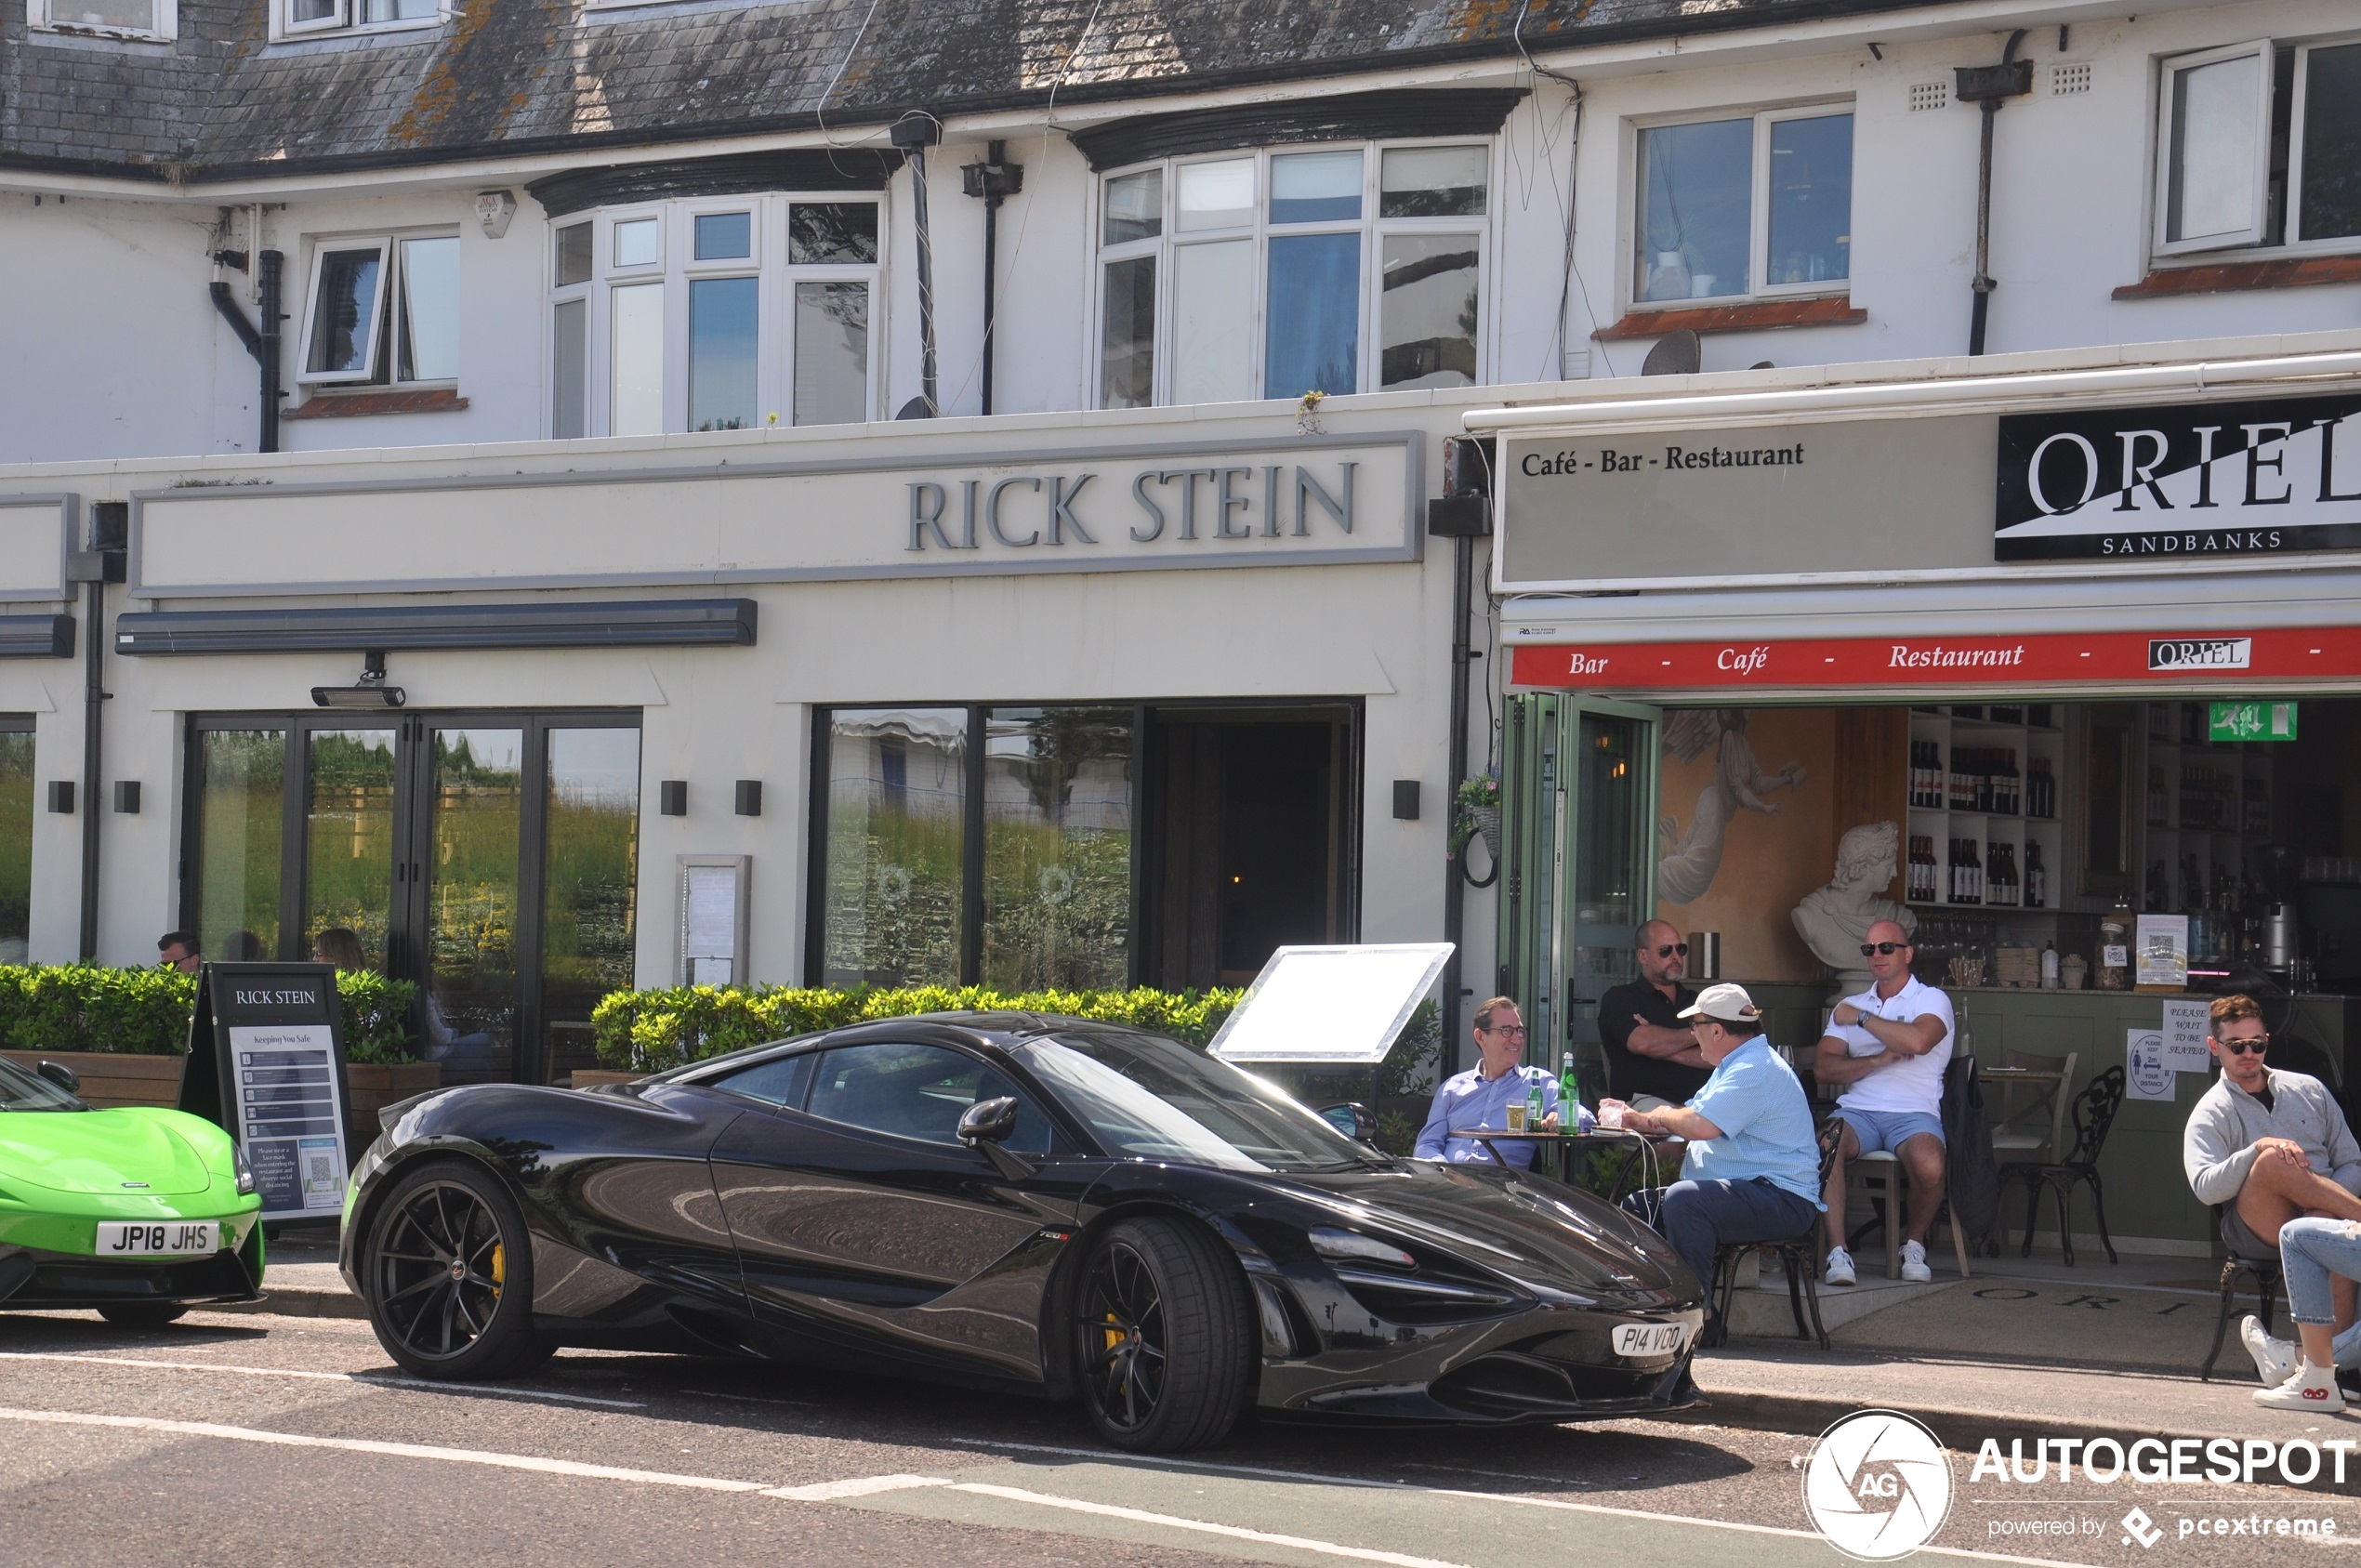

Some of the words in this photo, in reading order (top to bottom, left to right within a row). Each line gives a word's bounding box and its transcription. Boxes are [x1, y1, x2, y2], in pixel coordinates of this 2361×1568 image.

[1522, 451, 1577, 477] Café
[1601, 450, 1642, 473] Bar
[1665, 443, 1804, 470] Restaurant
[2028, 418, 2361, 517] ORIEL
[904, 474, 1100, 551] RICK
[1130, 462, 1360, 543] STEIN
[2103, 532, 2281, 554] SANDBANKS
[1569, 653, 1608, 675] Bar
[1717, 646, 1769, 675] Café
[1888, 644, 2025, 668] Restaurant
[2157, 642, 2243, 666] ORIEL
[235, 990, 272, 1004] RICK
[276, 990, 315, 1004] STEIN
[2170, 1008, 2207, 1018] PLEASE
[2175, 1021, 2202, 1030] WAIT
[254, 1035, 283, 1046] Keeping
[284, 1034, 296, 1043] You
[297, 1034, 311, 1043] Safe
[2173, 1034, 2186, 1042] TO
[2168, 1046, 2206, 1055] SEATED
[112, 1226, 165, 1251] JP18
[171, 1225, 207, 1250] JHS
[1621, 1328, 1651, 1351] P14
